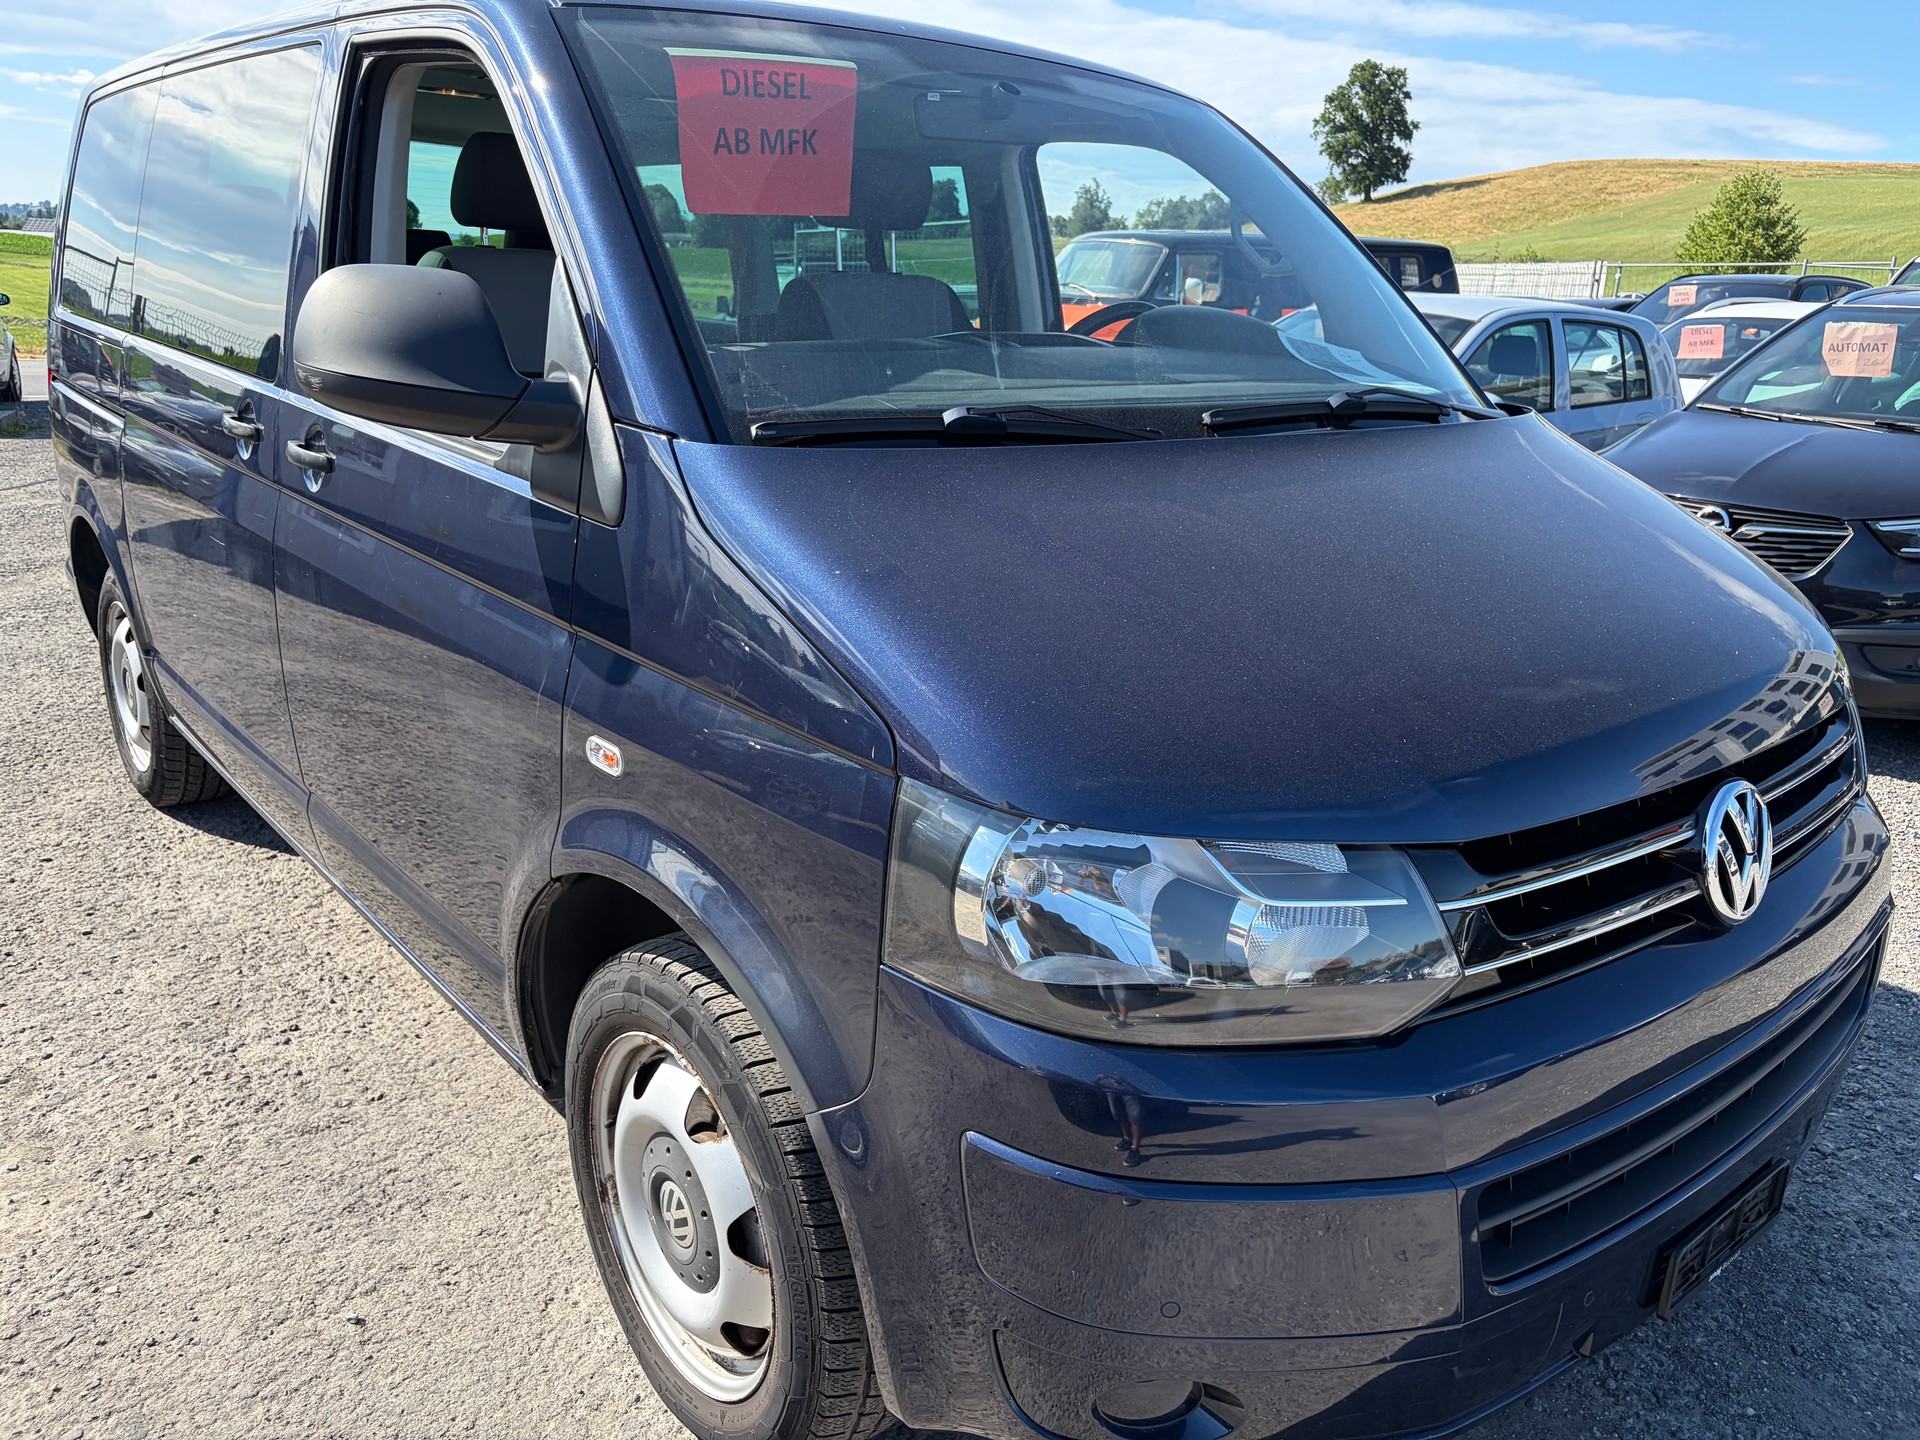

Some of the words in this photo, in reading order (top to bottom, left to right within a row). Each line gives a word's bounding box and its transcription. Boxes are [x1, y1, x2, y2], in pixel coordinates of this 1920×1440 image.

[720, 68, 812, 100] DIESEL
[713, 127, 751, 155] AB
[760, 128, 818, 156] MFK
[1698, 339, 1715, 347] MFK
[1828, 342, 1889, 353] AUTOMAT
